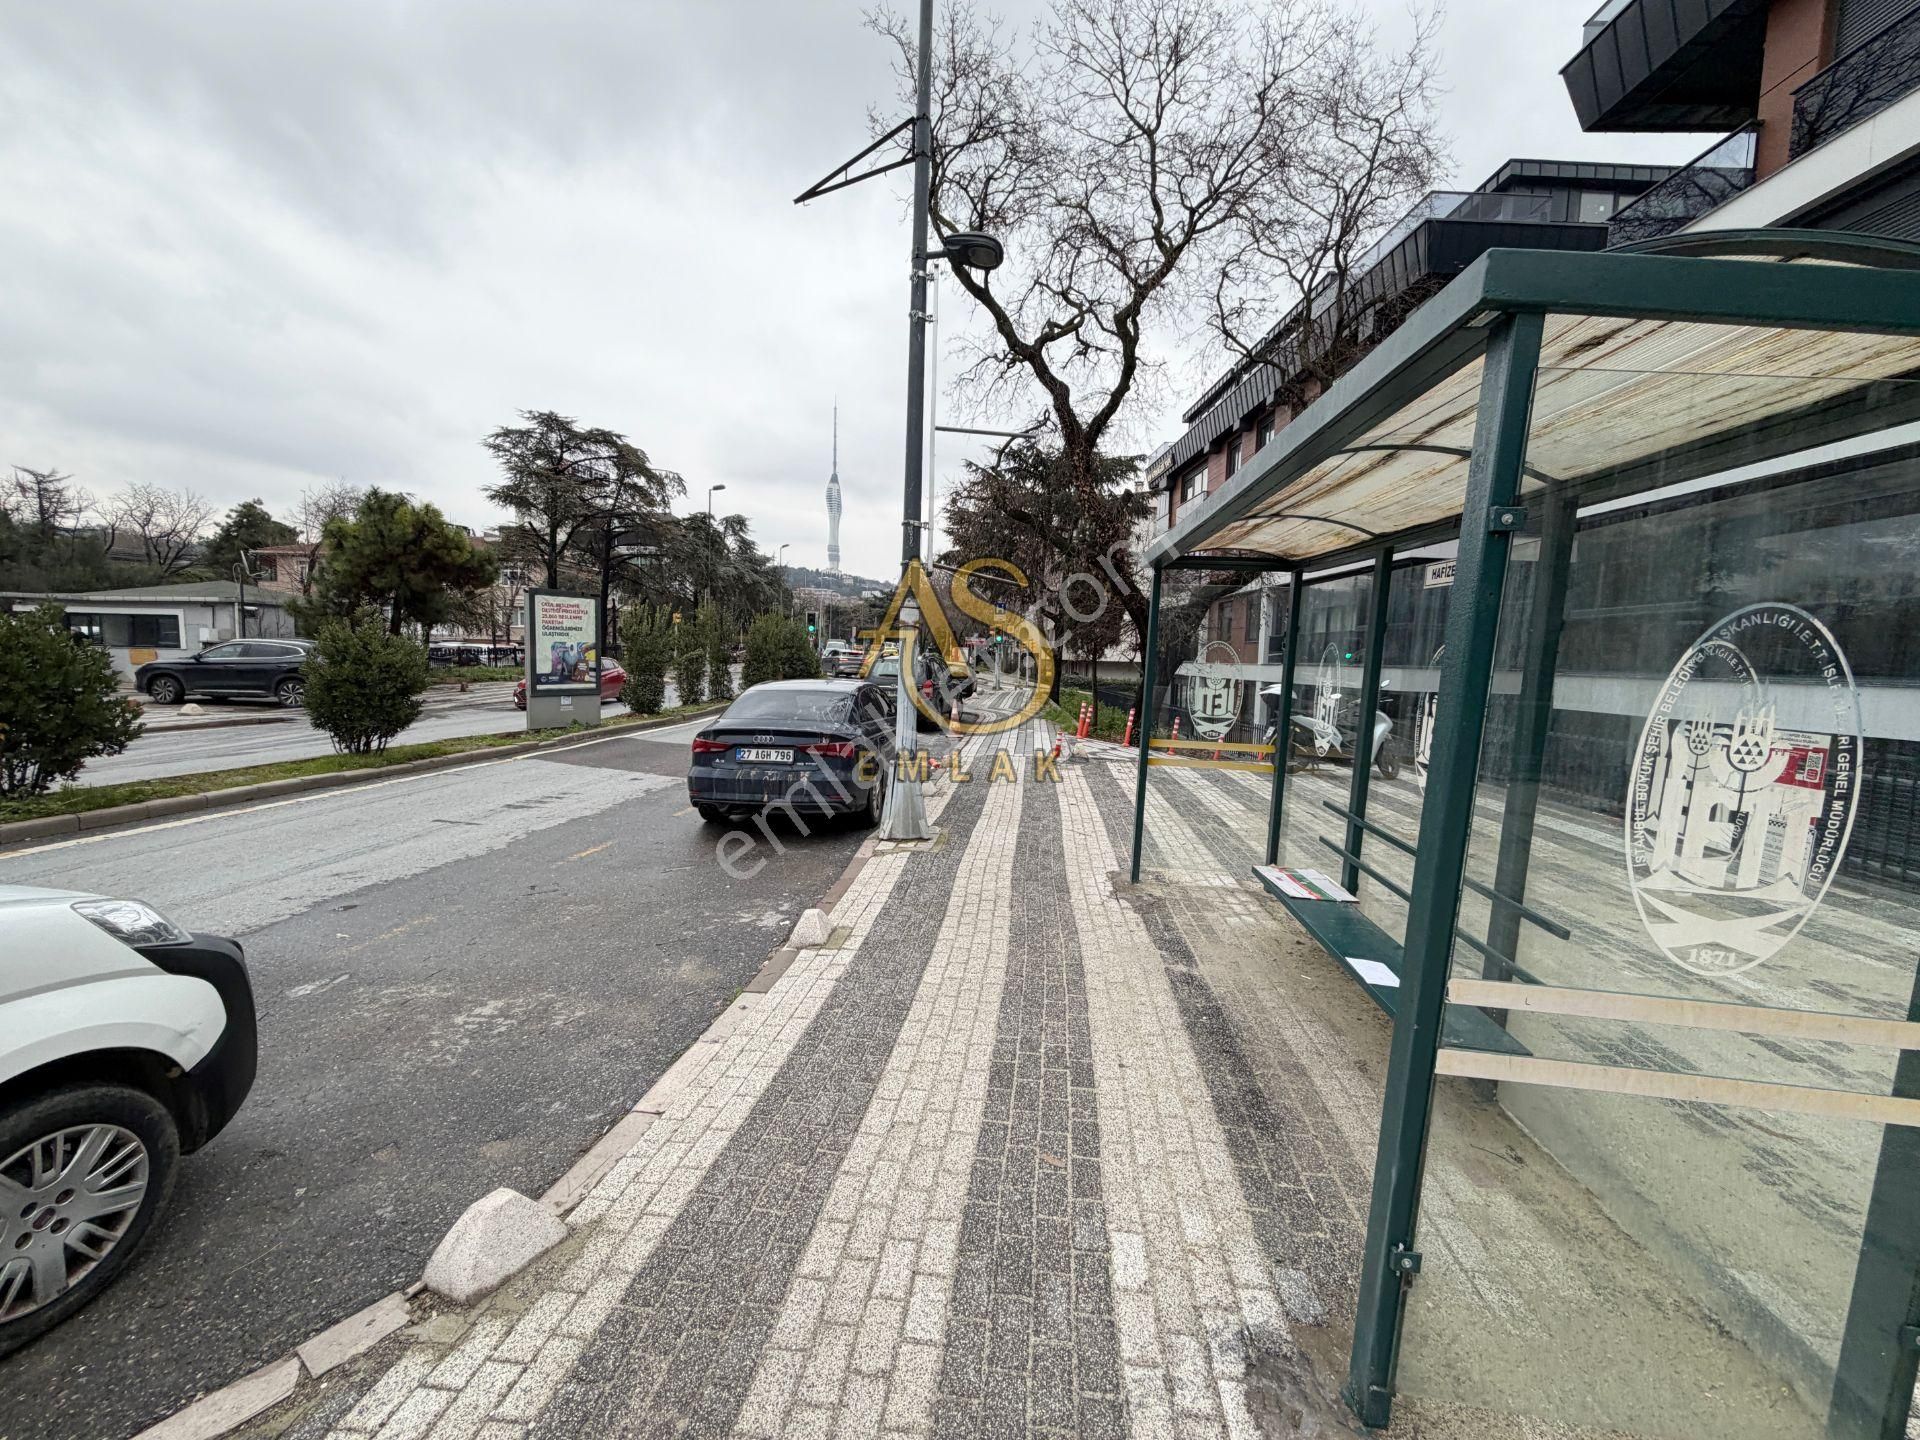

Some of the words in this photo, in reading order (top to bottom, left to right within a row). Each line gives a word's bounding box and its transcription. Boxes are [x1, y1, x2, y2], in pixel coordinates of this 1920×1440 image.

[741, 749, 752, 759] 27
[755, 750, 772, 760] AGH
[774, 751, 792, 761] 796
[1833, 753, 1851, 797] GENEL
[1807, 800, 1845, 882] MÜDÜRLÜĞÜ
[1686, 948, 1737, 968] 1871
